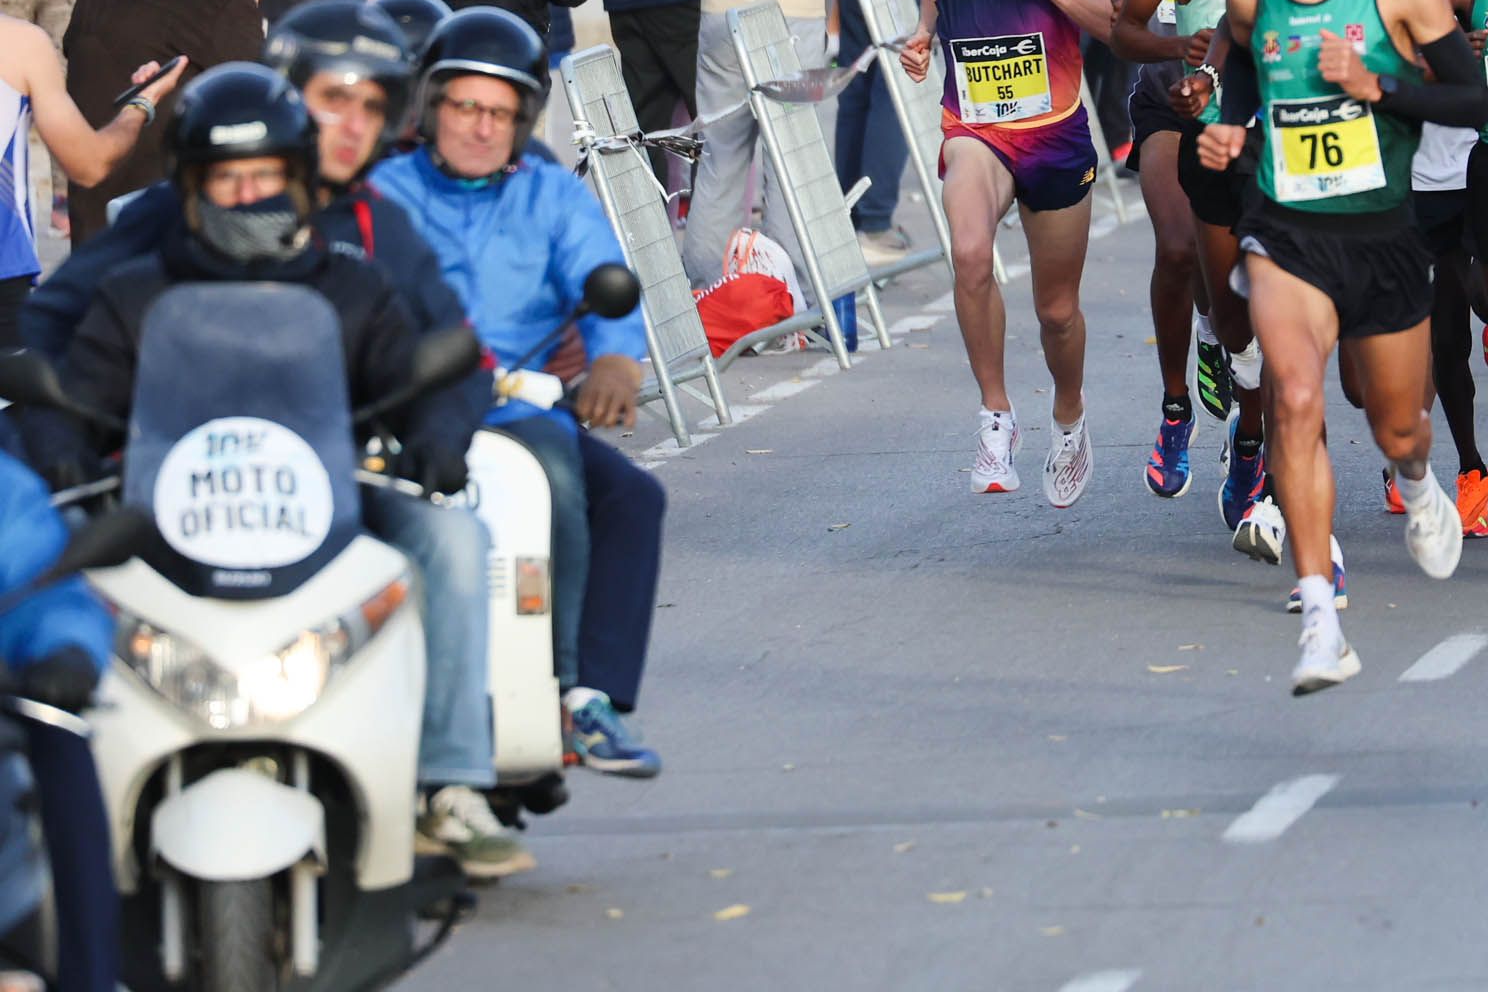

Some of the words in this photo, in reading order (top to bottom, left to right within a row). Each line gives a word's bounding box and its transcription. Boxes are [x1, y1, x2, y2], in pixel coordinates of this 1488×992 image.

[961, 45, 1007, 57] iberCaja
[965, 58, 1042, 83] BUTCHART
[996, 85, 1014, 100] 55
[1300, 132, 1343, 170] 76
[189, 464, 297, 498] MOTO
[180, 500, 313, 538] OFICIAL
